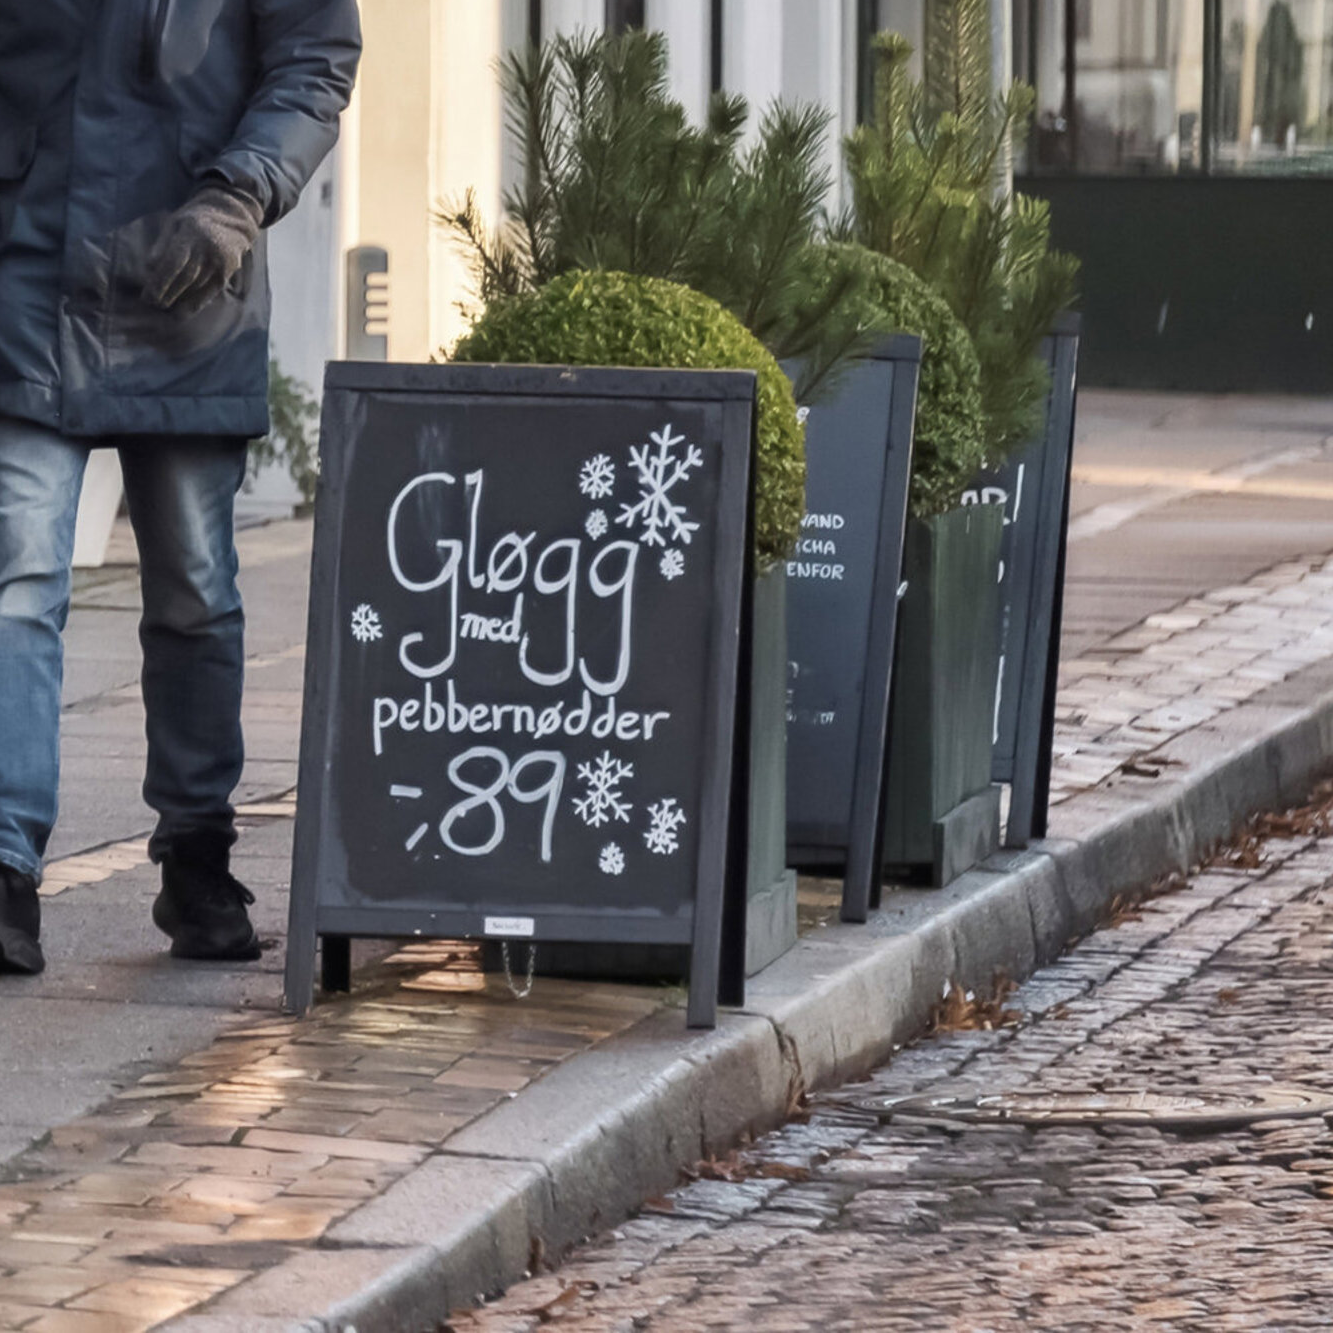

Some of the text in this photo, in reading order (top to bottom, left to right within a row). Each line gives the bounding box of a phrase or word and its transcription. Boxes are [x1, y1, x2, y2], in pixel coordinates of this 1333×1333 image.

[386, 468, 641, 698] Gløgg
[459, 592, 524, 646] med
[371, 678, 671, 756] pebbernødder
